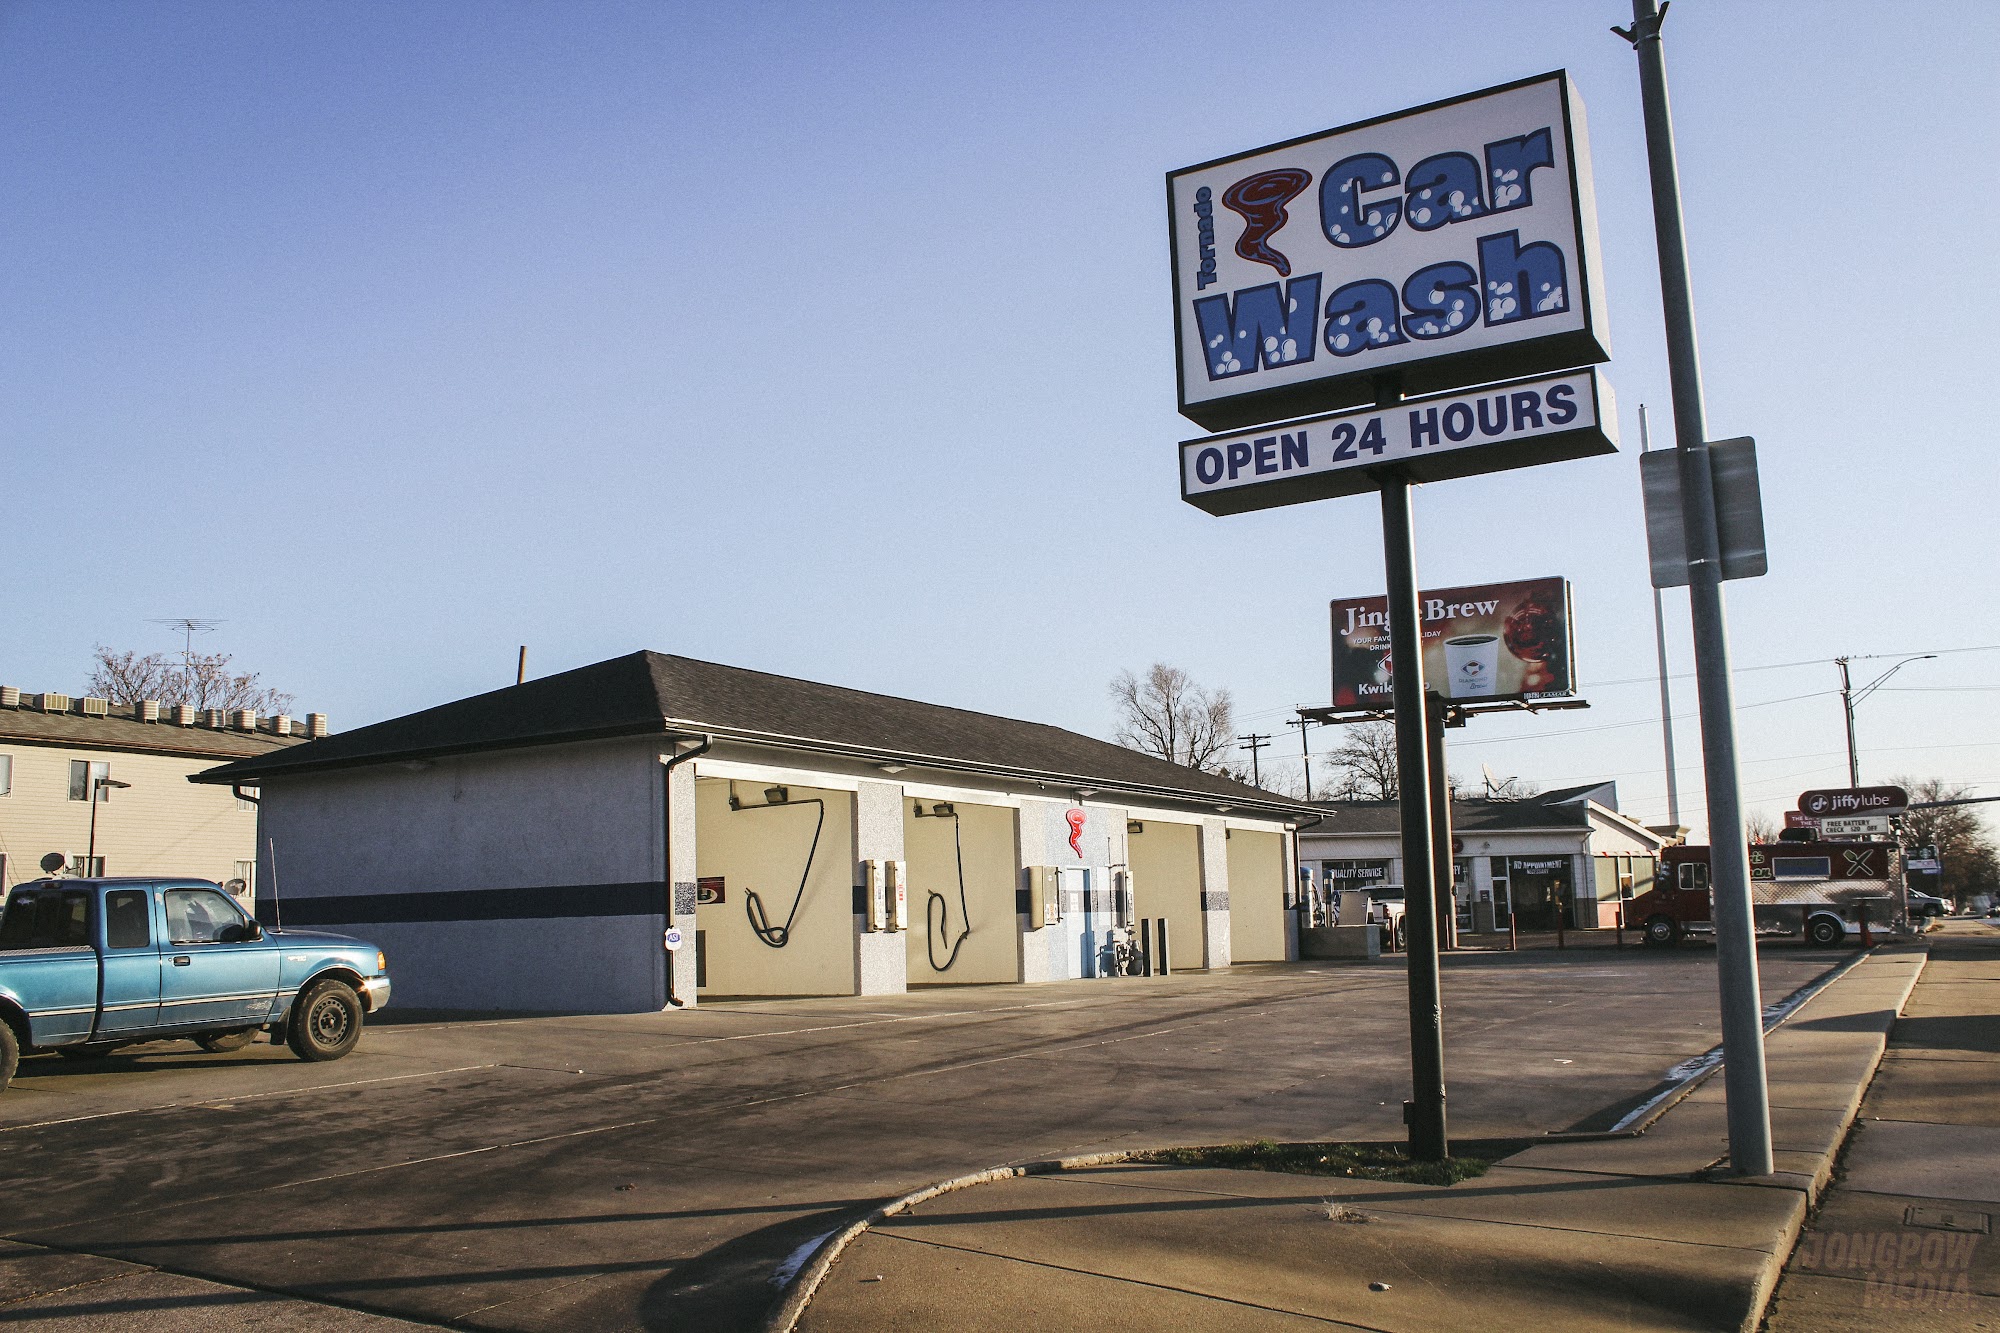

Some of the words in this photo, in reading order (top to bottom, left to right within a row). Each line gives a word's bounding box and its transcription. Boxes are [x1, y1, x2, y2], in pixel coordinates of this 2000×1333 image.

[1319, 126, 1555, 249] Car
[1194, 186, 1217, 290] Tornado
[1193, 228, 1570, 382] Wash
[1196, 431, 1309, 485] OPEN
[1331, 418, 1386, 463] 24
[1409, 384, 1578, 449] HOURS
[1424, 599, 1499, 621] Brew
[1353, 637, 1372, 645] YOUR
[1358, 682, 1393, 695] Kwik
[1843, 819, 1870, 827] BATTERY
[1357, 867, 1383, 878] SERVICE
[1513, 860, 1522, 869] NO
[1523, 860, 1562, 869] APPOINTMENT
